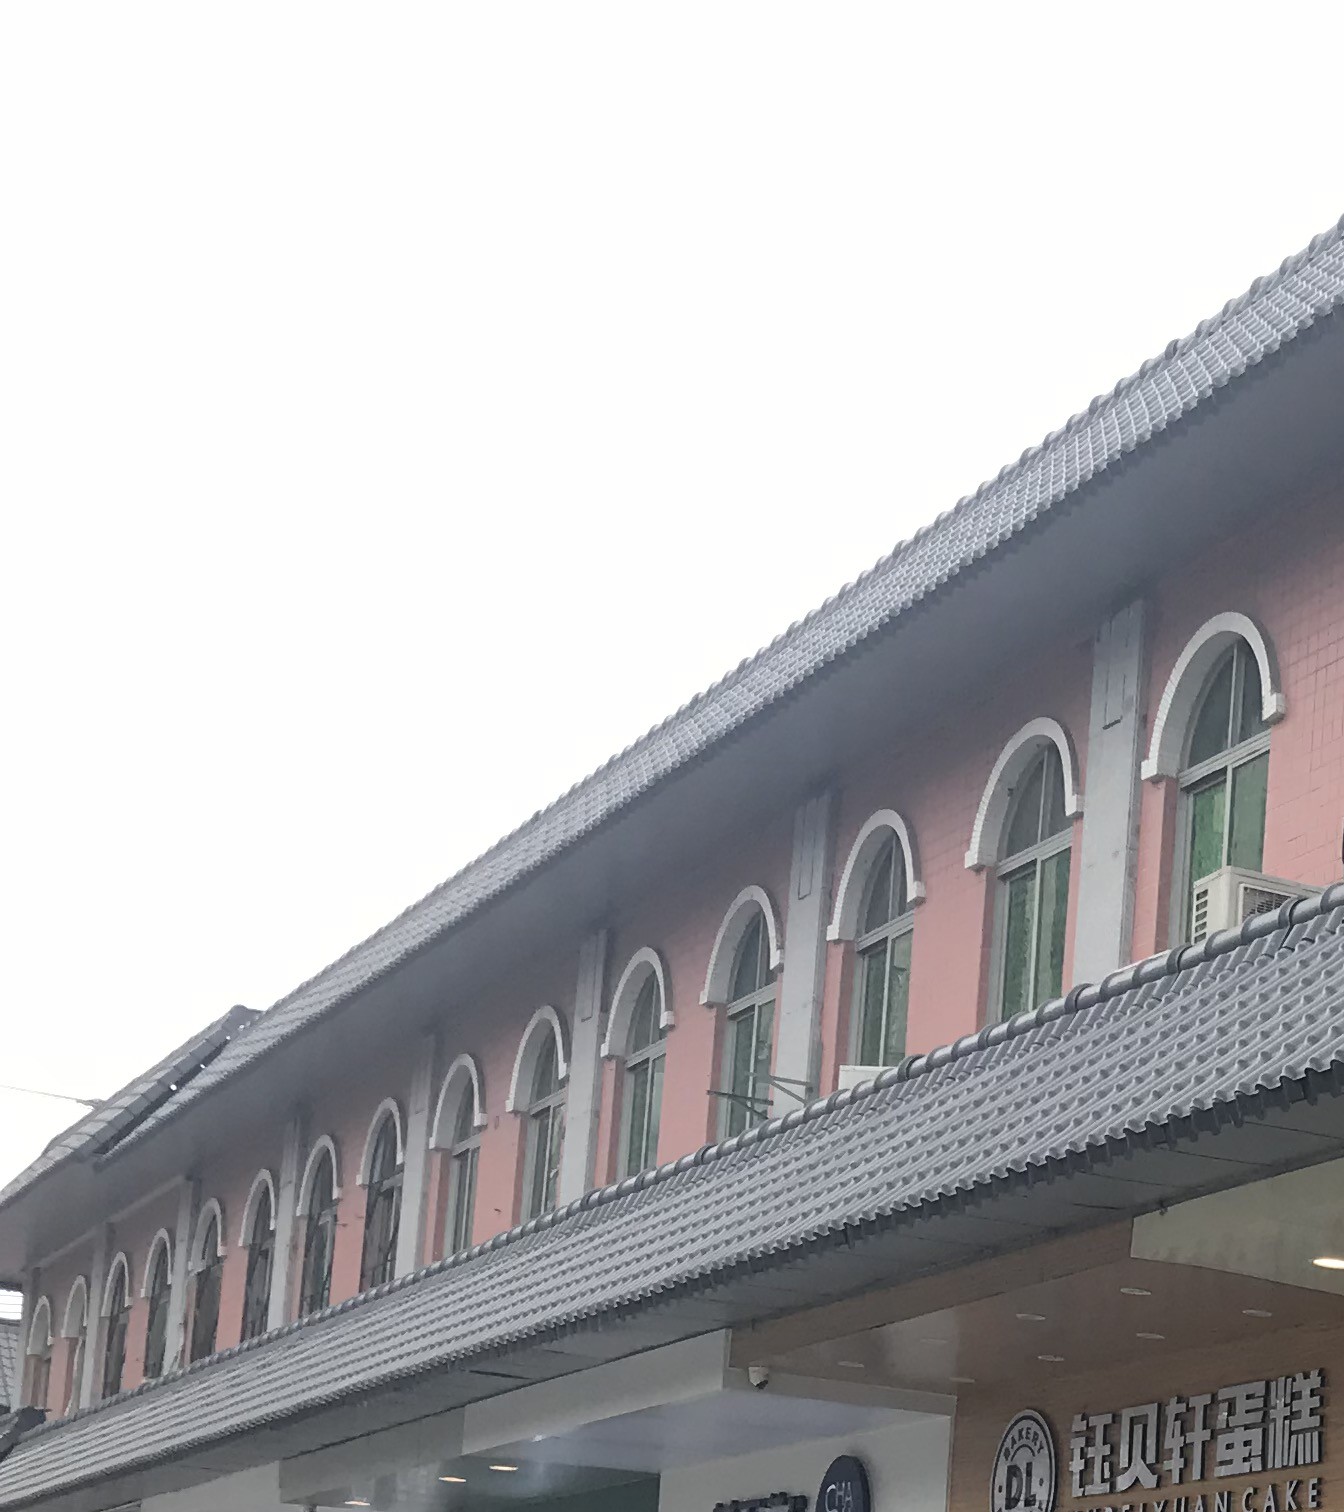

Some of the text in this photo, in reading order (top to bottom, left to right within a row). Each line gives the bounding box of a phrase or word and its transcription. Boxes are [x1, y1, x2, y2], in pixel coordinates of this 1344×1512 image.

[1003, 1426, 1044, 1461] BAKERY
[1068, 1367, 1324, 1498] 钰贝轩蛋糕
[1005, 1461, 1036, 1510] DL
